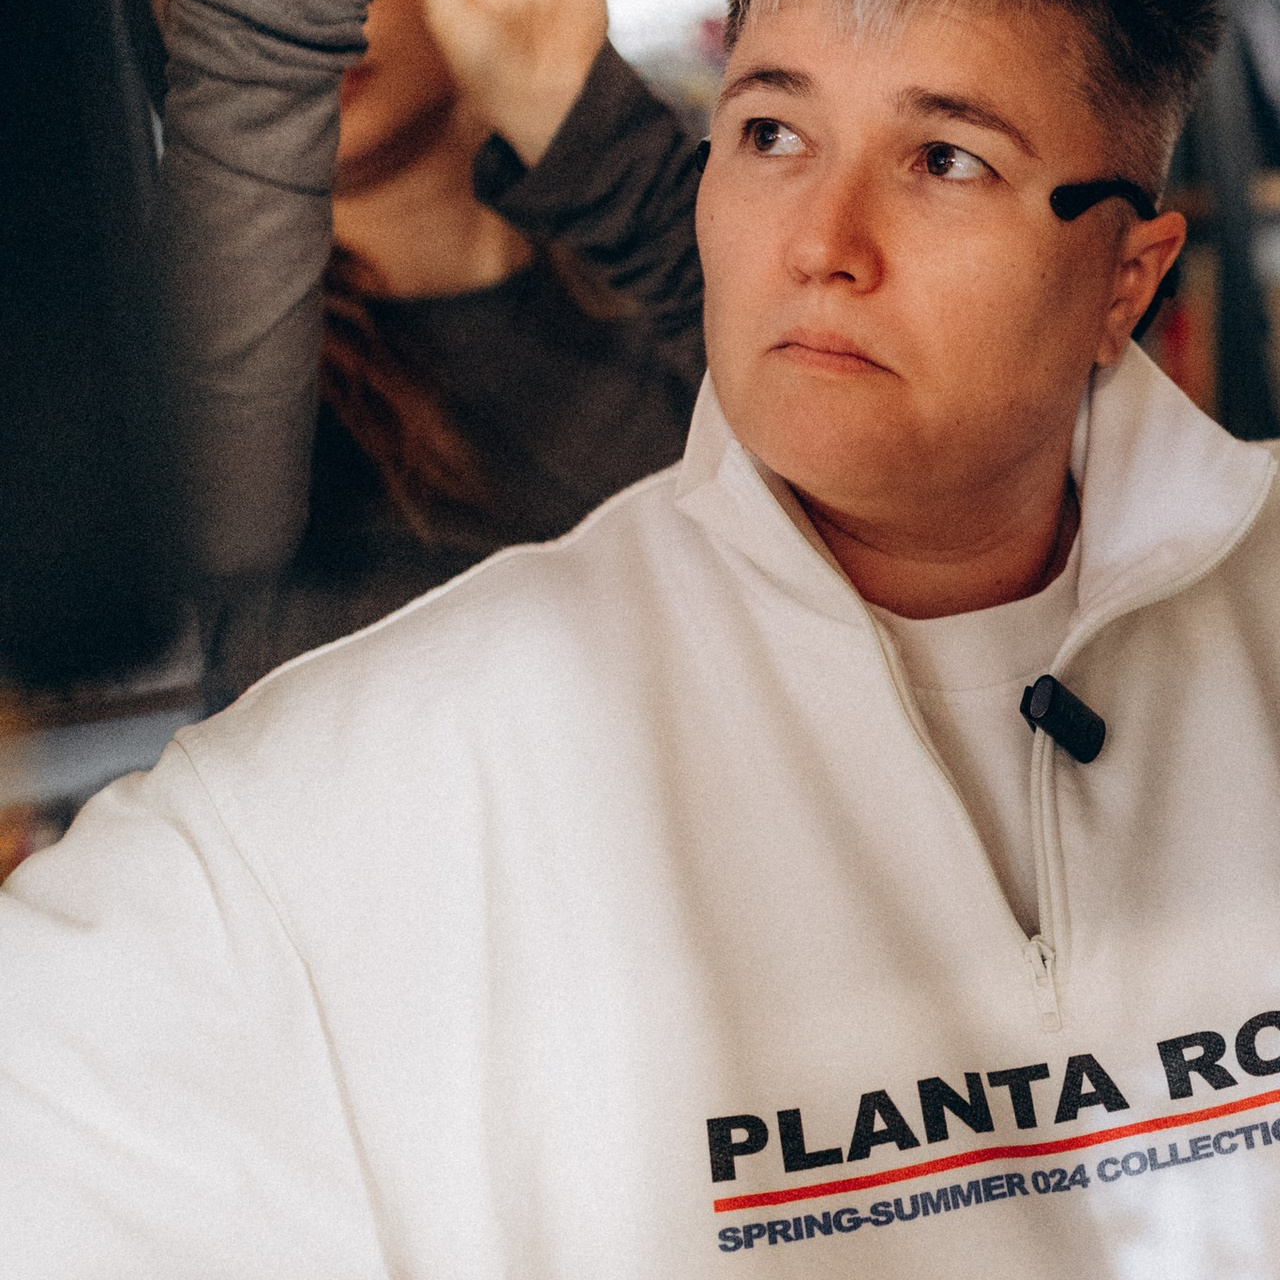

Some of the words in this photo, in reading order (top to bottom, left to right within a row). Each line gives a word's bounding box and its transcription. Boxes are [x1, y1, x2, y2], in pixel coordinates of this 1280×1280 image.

[705, 1053, 1130, 1183] PLANTA
[717, 1173, 1030, 1253] SPRING-SUMMER
[1031, 1164, 1091, 1194] 024
